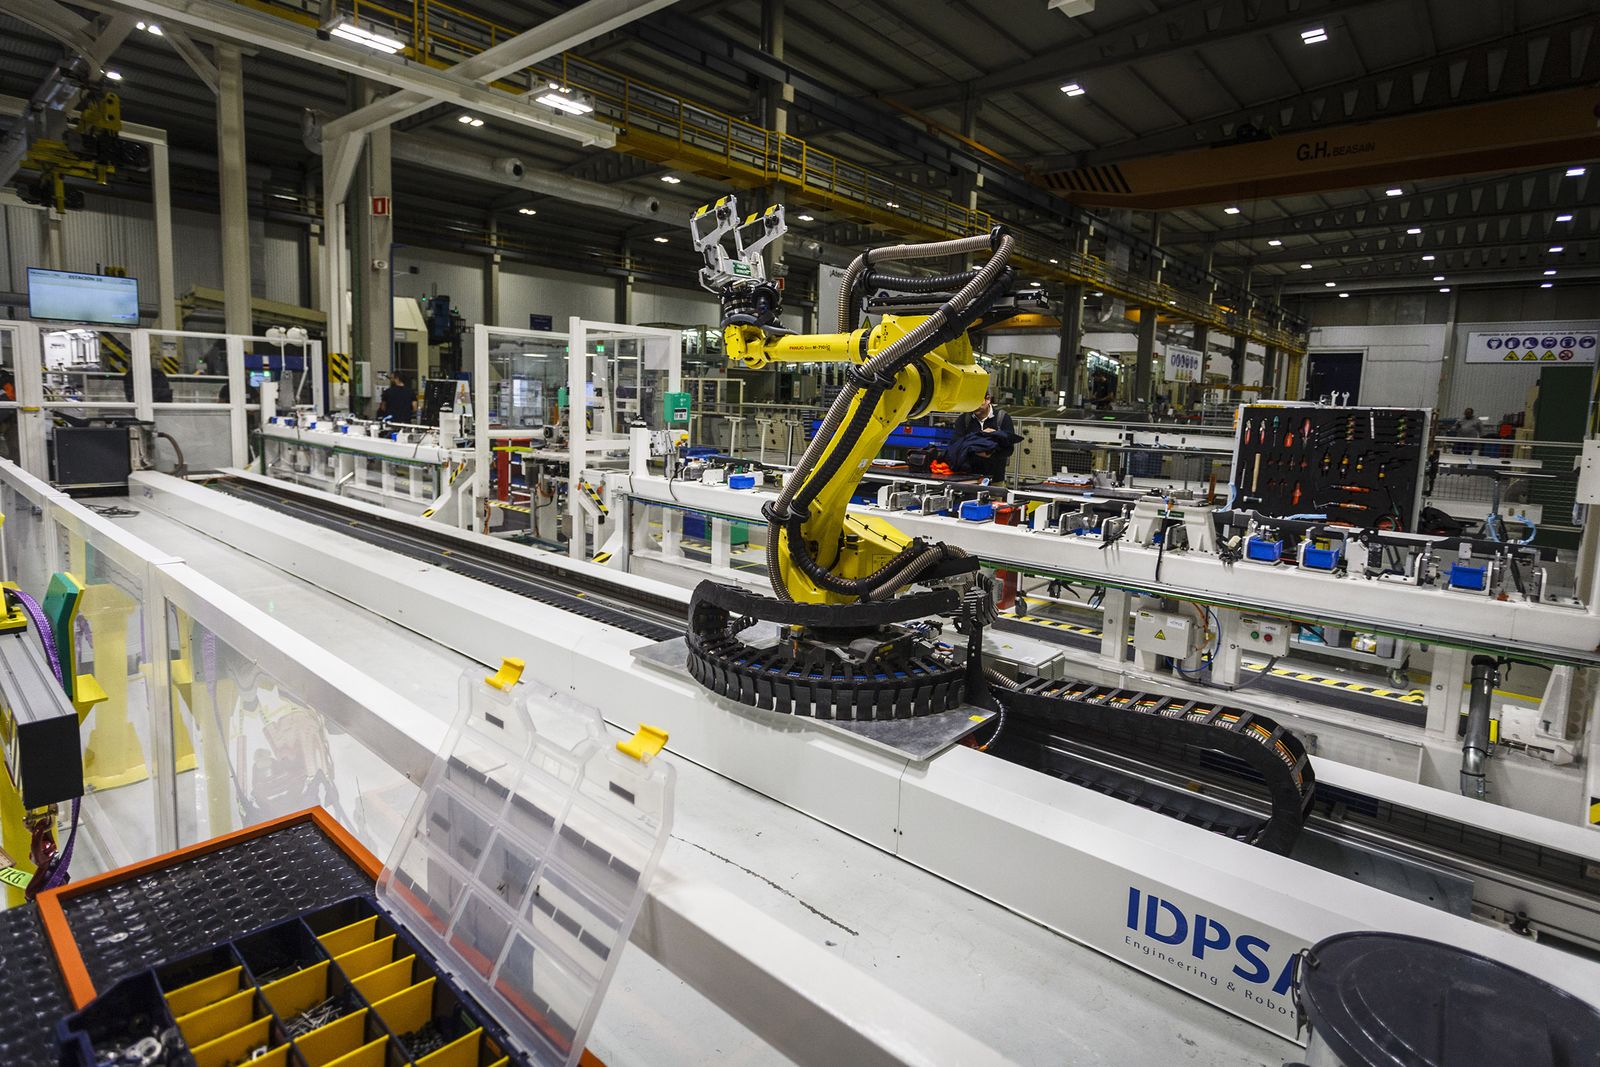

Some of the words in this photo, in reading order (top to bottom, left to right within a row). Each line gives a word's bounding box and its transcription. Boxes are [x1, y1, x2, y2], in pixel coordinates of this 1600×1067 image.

[1332, 142, 1376, 157] BEASAIN
[1124, 935, 1219, 986] Engineering
[1226, 981, 1236, 993] &
